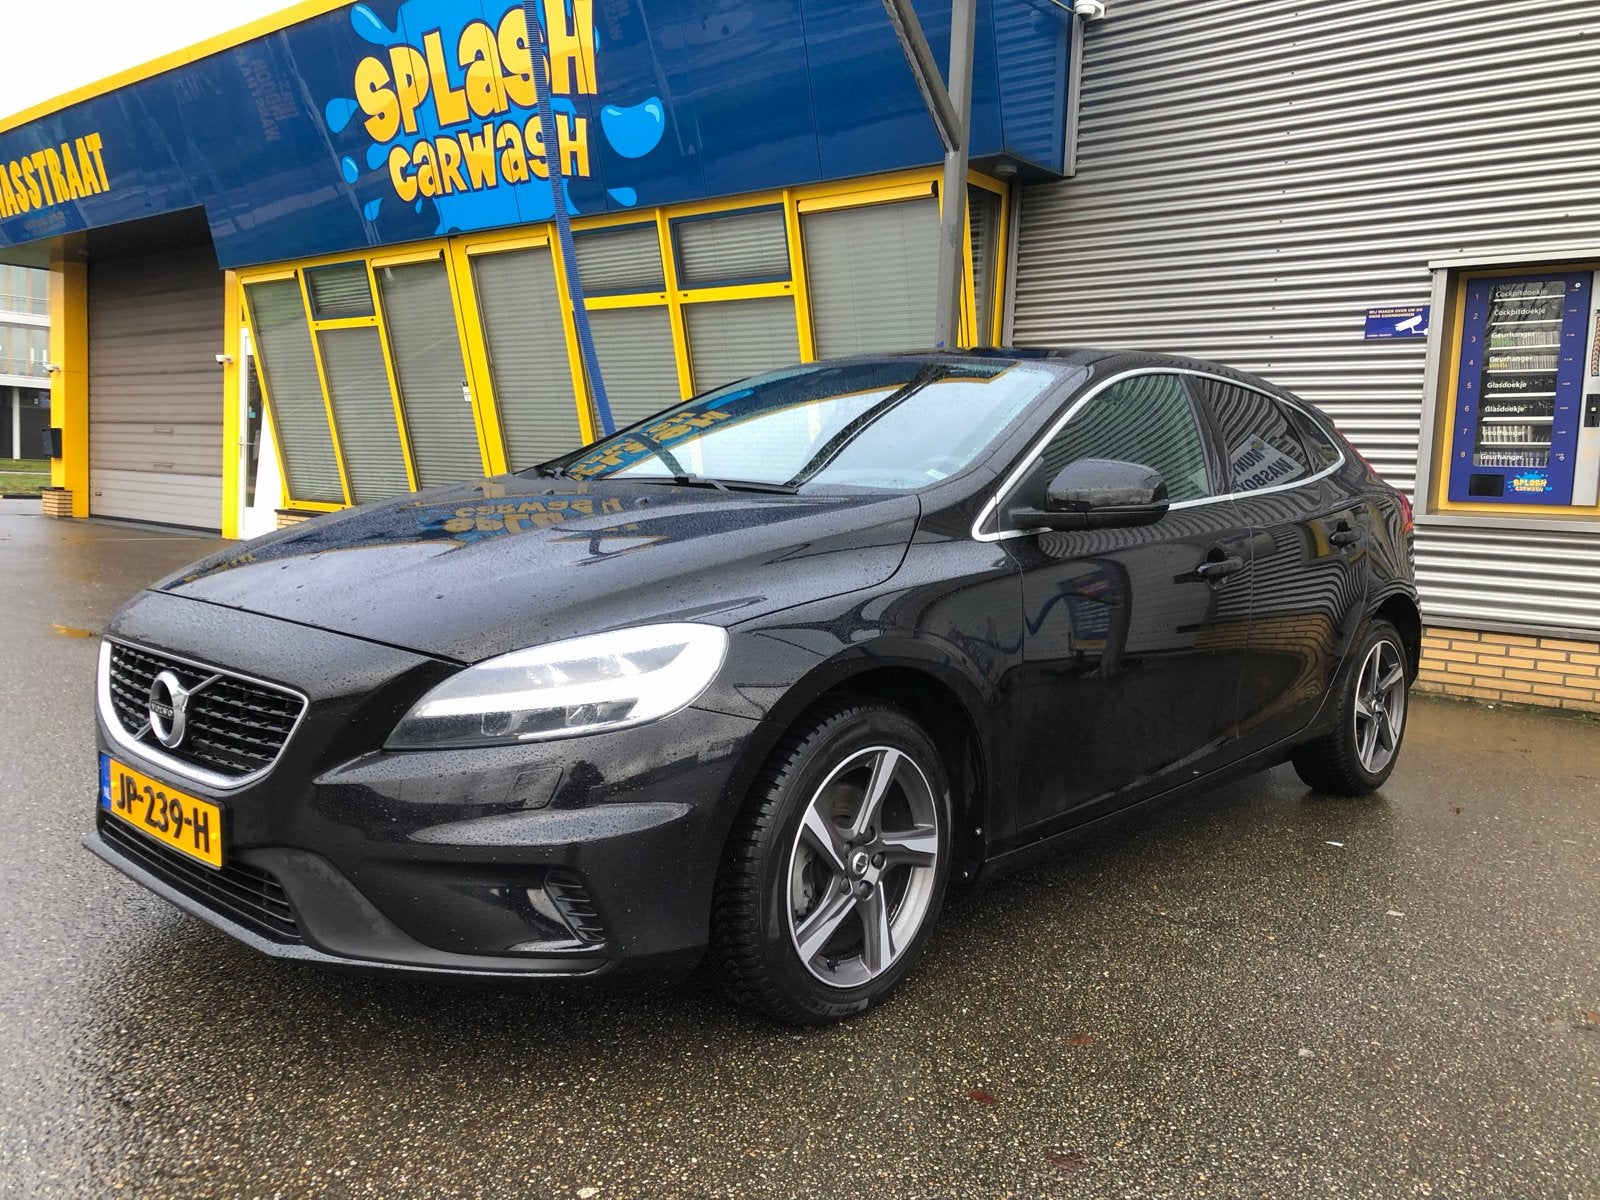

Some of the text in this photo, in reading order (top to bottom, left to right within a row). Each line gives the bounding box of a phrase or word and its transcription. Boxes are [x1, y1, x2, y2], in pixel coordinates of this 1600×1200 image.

[1495, 289, 1548, 298] Cockpitdoekje
[1493, 308, 1546, 317] Cockpitdoekje
[1491, 331, 1535, 340] Geurhanger
[1489, 355, 1534, 364] Geurhanger
[1486, 381, 1527, 389] Glasdoekje
[1484, 405, 1525, 413] Glasdoekje
[1482, 429, 1525, 438] Geurhanger
[1480, 453, 1523, 461] Geurhanger
[116, 772, 211, 854] JP-239-H
